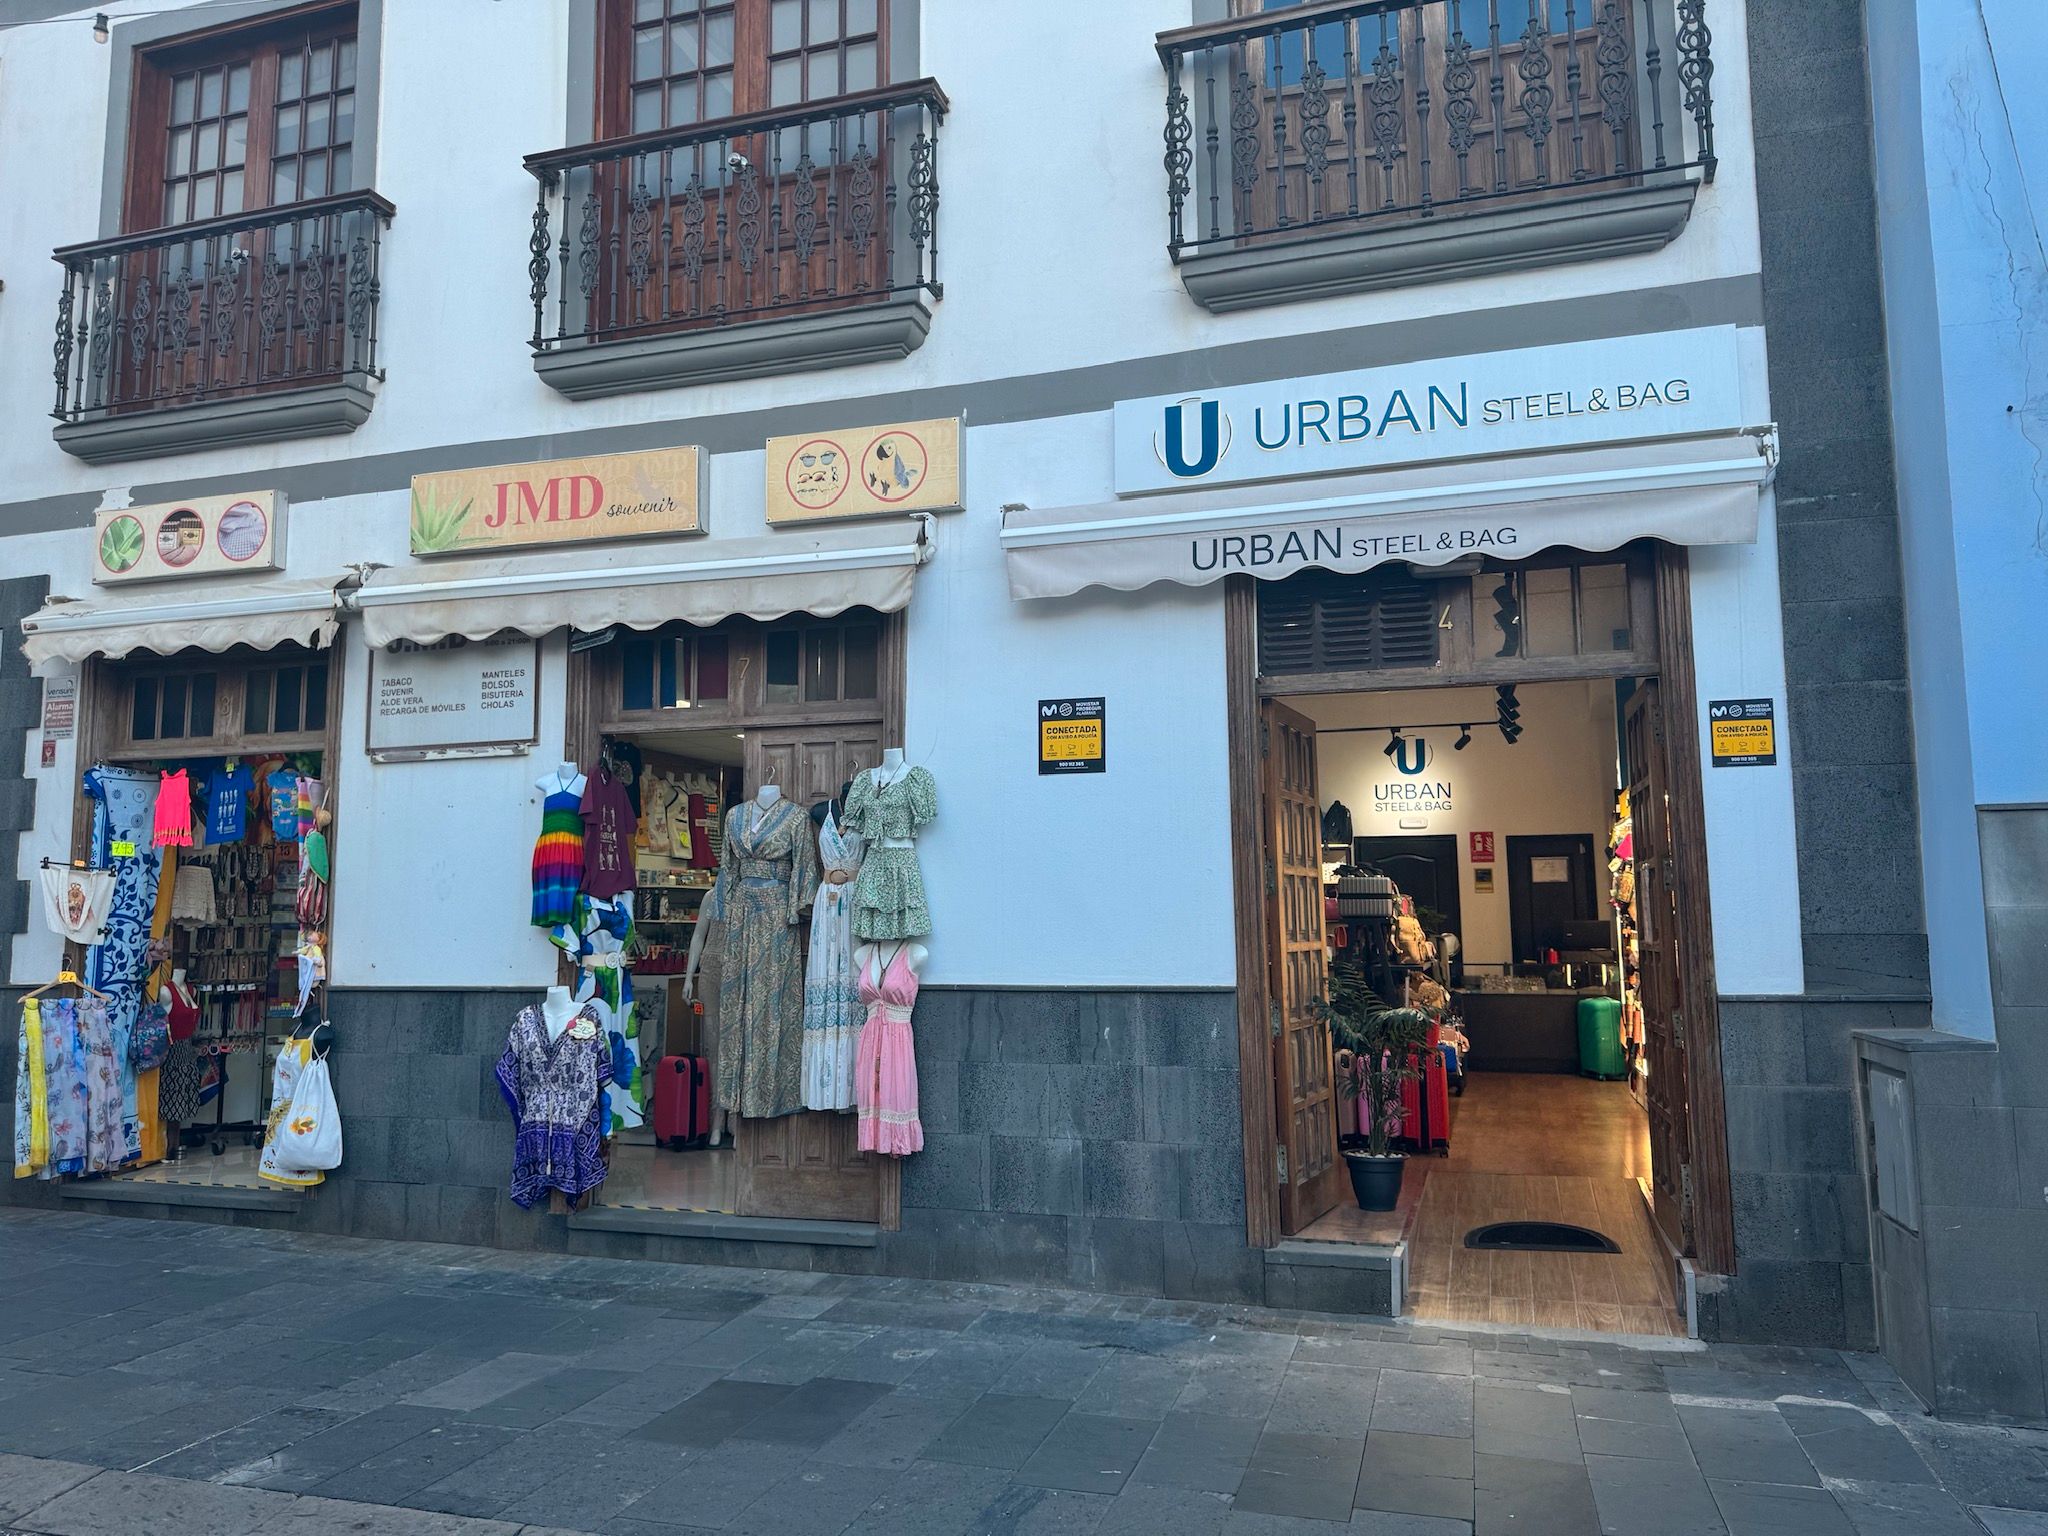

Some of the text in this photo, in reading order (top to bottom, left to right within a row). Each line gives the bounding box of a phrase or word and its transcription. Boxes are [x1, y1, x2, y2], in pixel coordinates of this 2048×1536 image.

[1255, 382, 1468, 450] URBAN
[484, 475, 604, 528] JMD
[607, 497, 678, 518] souvenir
[1193, 528, 1341, 570] URBAN
[1352, 534, 1430, 556] STEEL
[1460, 528, 1517, 547] BAG
[1439, 604, 1453, 629] 4
[740, 658, 750, 679] 7
[482, 669, 525, 678] MANTELES
[382, 678, 412, 687] TABACO
[482, 680, 515, 689] BOLSOS
[381, 688, 414, 697] SUVENIR
[380, 697, 423, 706] ALOE VERA
[481, 700, 514, 709] CHOLAS
[46, 703, 73, 711] Alarma
[380, 707, 417, 716] RECARGA
[1046, 726, 1097, 734] CONECTADA
[1717, 725, 1768, 733] CONECTADA
[1375, 783, 1451, 800] URBAN
